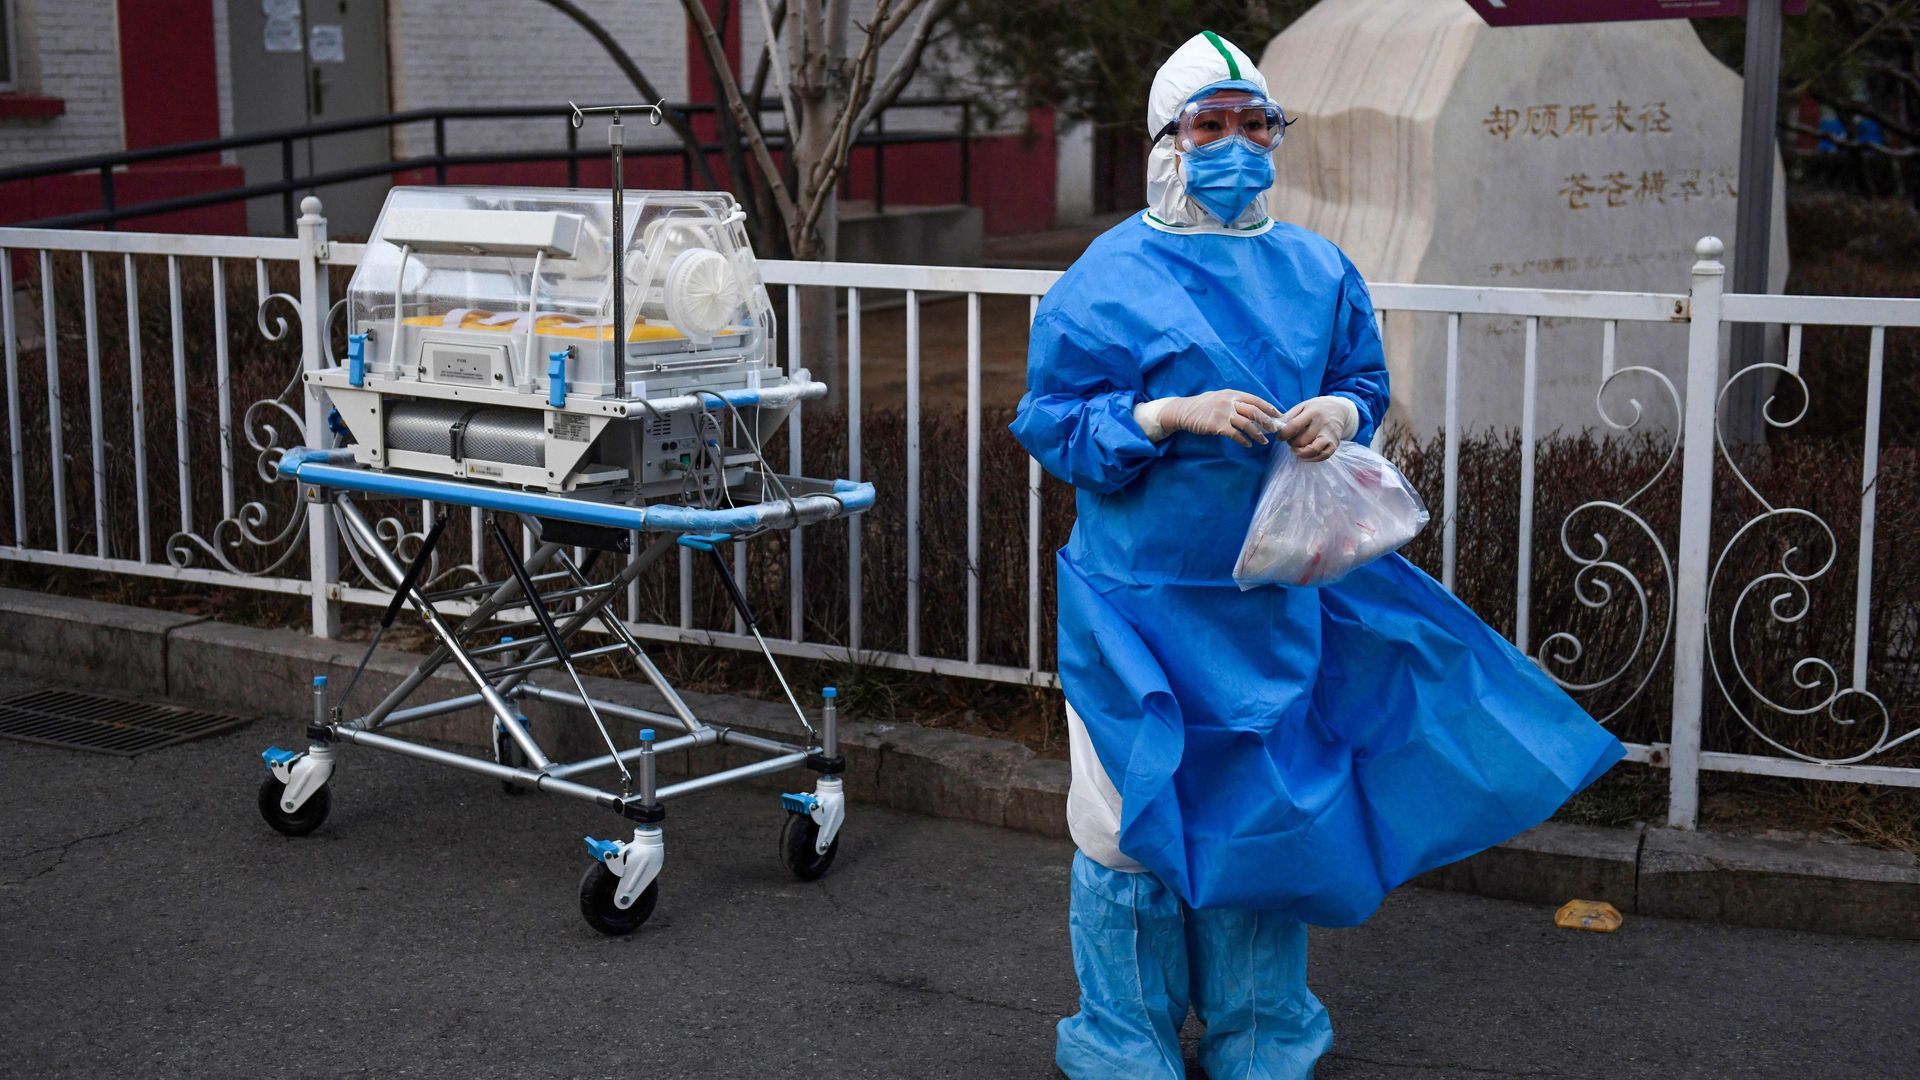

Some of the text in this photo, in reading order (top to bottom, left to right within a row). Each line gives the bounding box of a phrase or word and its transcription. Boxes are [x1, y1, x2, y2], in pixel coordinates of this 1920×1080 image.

[1483, 100, 1672, 140] 却顾所来径
